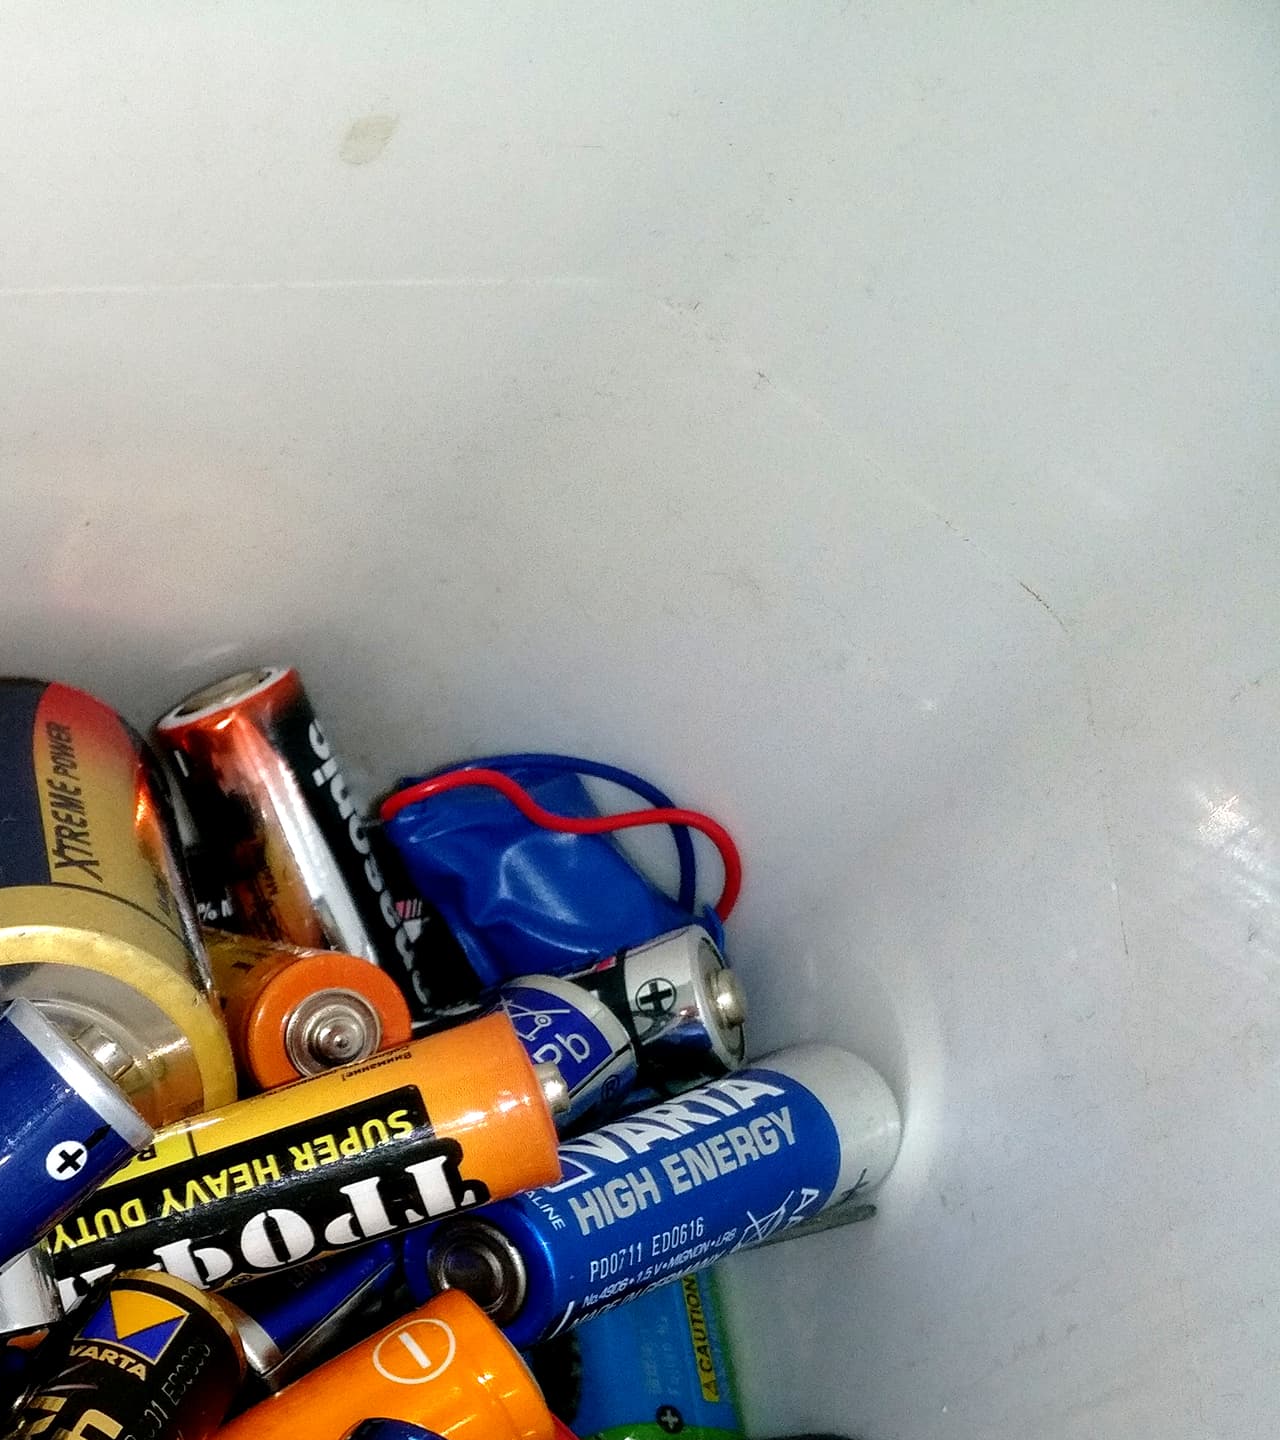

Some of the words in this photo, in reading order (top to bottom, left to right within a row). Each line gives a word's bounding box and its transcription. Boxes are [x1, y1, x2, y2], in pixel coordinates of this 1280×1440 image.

[49, 772, 103, 882] XTREME
[291, 1108, 414, 1173] SUPER
[558, 1078, 785, 1164] VARTA
[159, 1154, 280, 1219] HEAVY
[568, 1167, 662, 1236] HIGH
[660, 1106, 797, 1196] ENERGY
[53, 1198, 146, 1253] DUTY
[69, 1345, 147, 1382] VARTA
